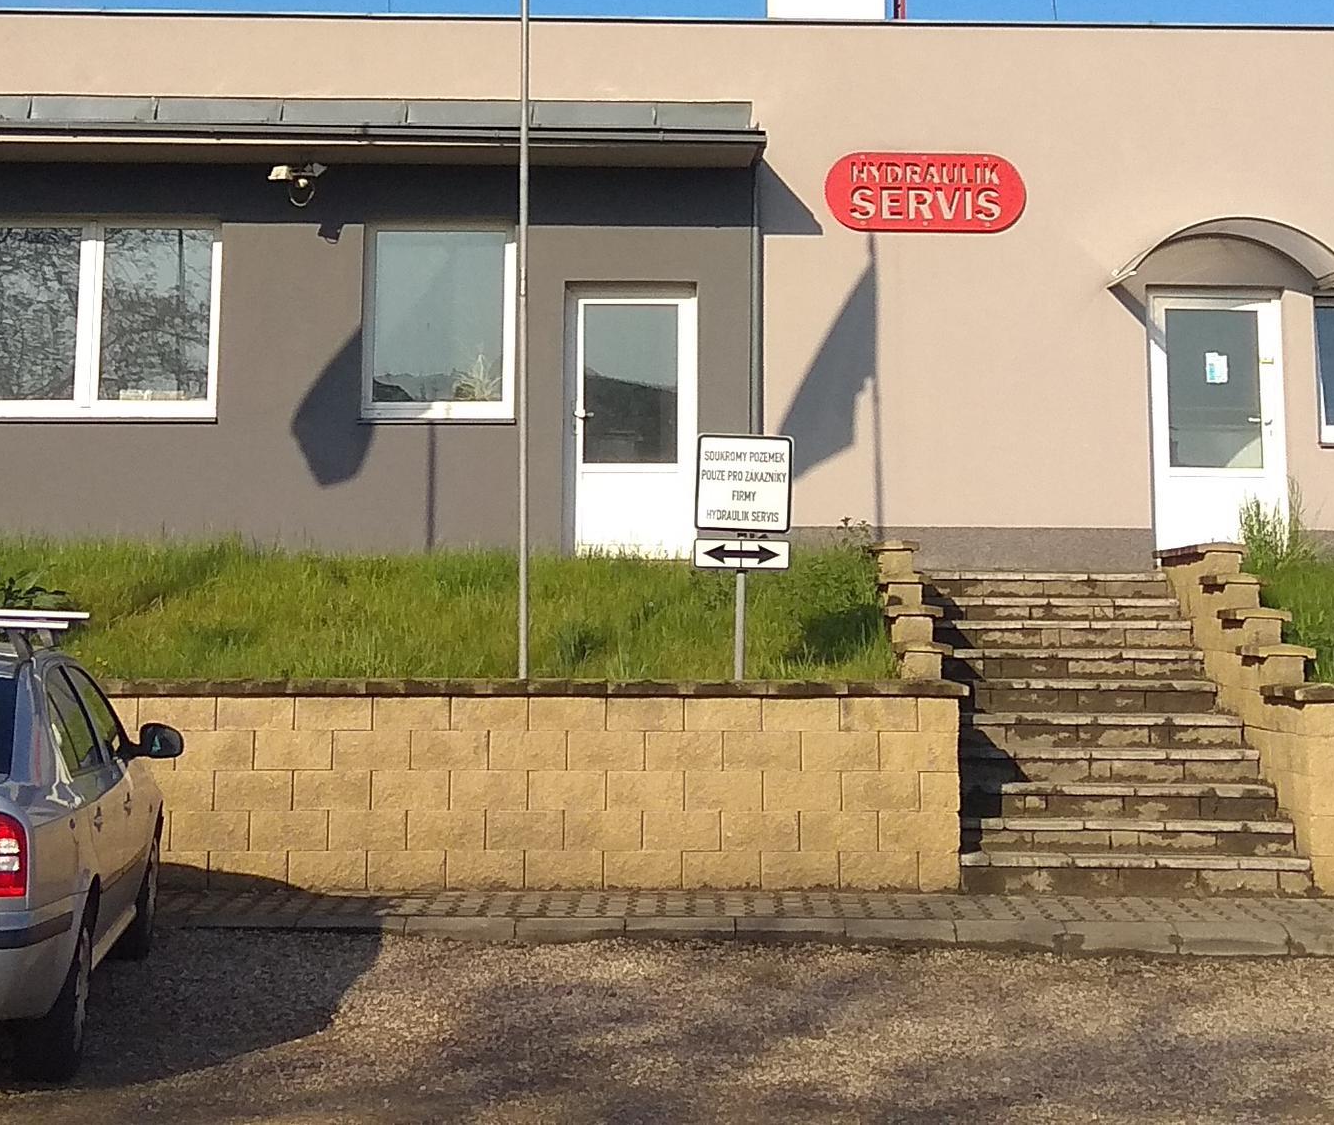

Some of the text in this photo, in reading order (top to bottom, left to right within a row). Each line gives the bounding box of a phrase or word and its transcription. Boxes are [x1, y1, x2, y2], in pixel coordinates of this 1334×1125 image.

[850, 161, 1001, 186] HYDRAULIK
[849, 185, 1002, 221] SERVIS
[749, 451, 785, 463] POZEMEK
[701, 469, 726, 481] POUZE
[727, 470, 743, 482] PRO
[731, 490, 757, 502] FIRMY
[706, 509, 780, 523] HYDRAULIK SERVIS
